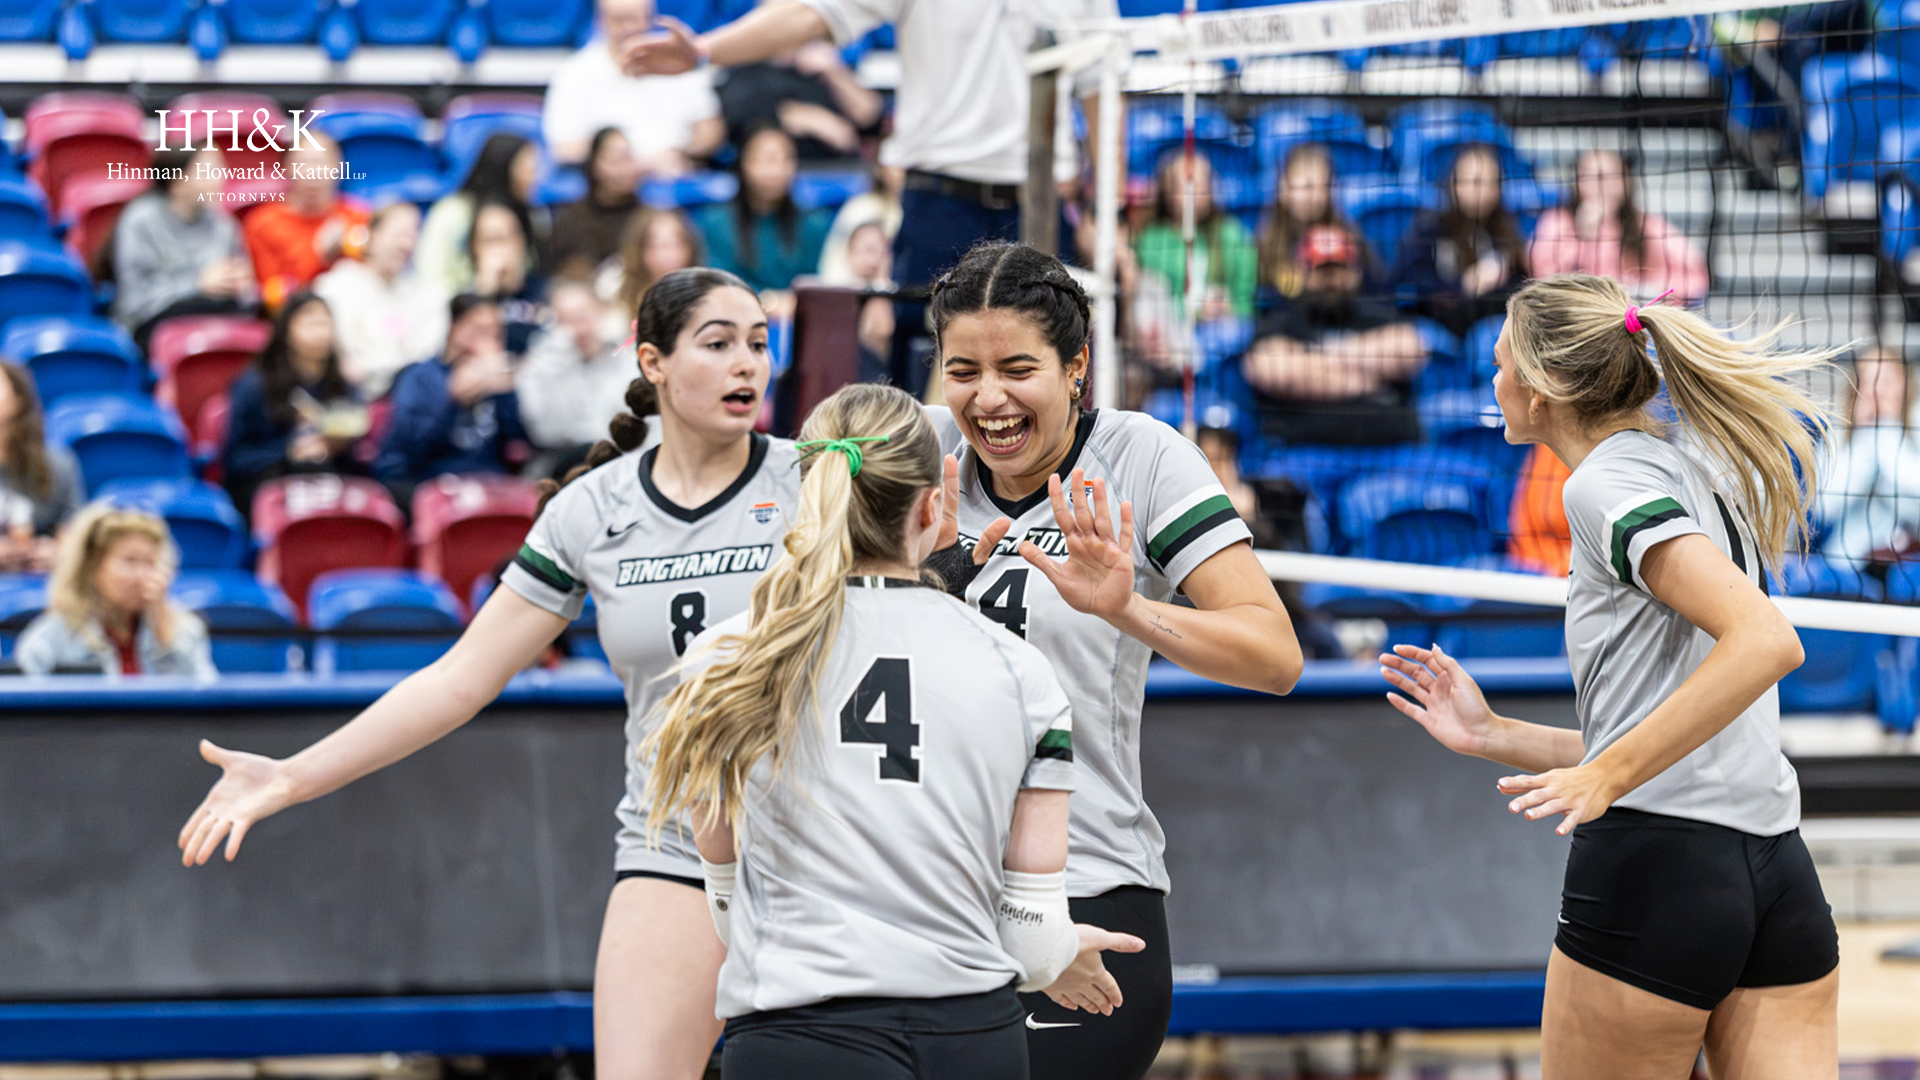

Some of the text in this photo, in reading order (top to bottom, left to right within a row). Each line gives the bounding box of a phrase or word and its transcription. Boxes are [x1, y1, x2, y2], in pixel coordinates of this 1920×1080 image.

[616, 545, 774, 587] BINGHAMTON
[668, 589, 708, 658] 8
[978, 567, 1030, 641] 4
[838, 656, 923, 784] 4
